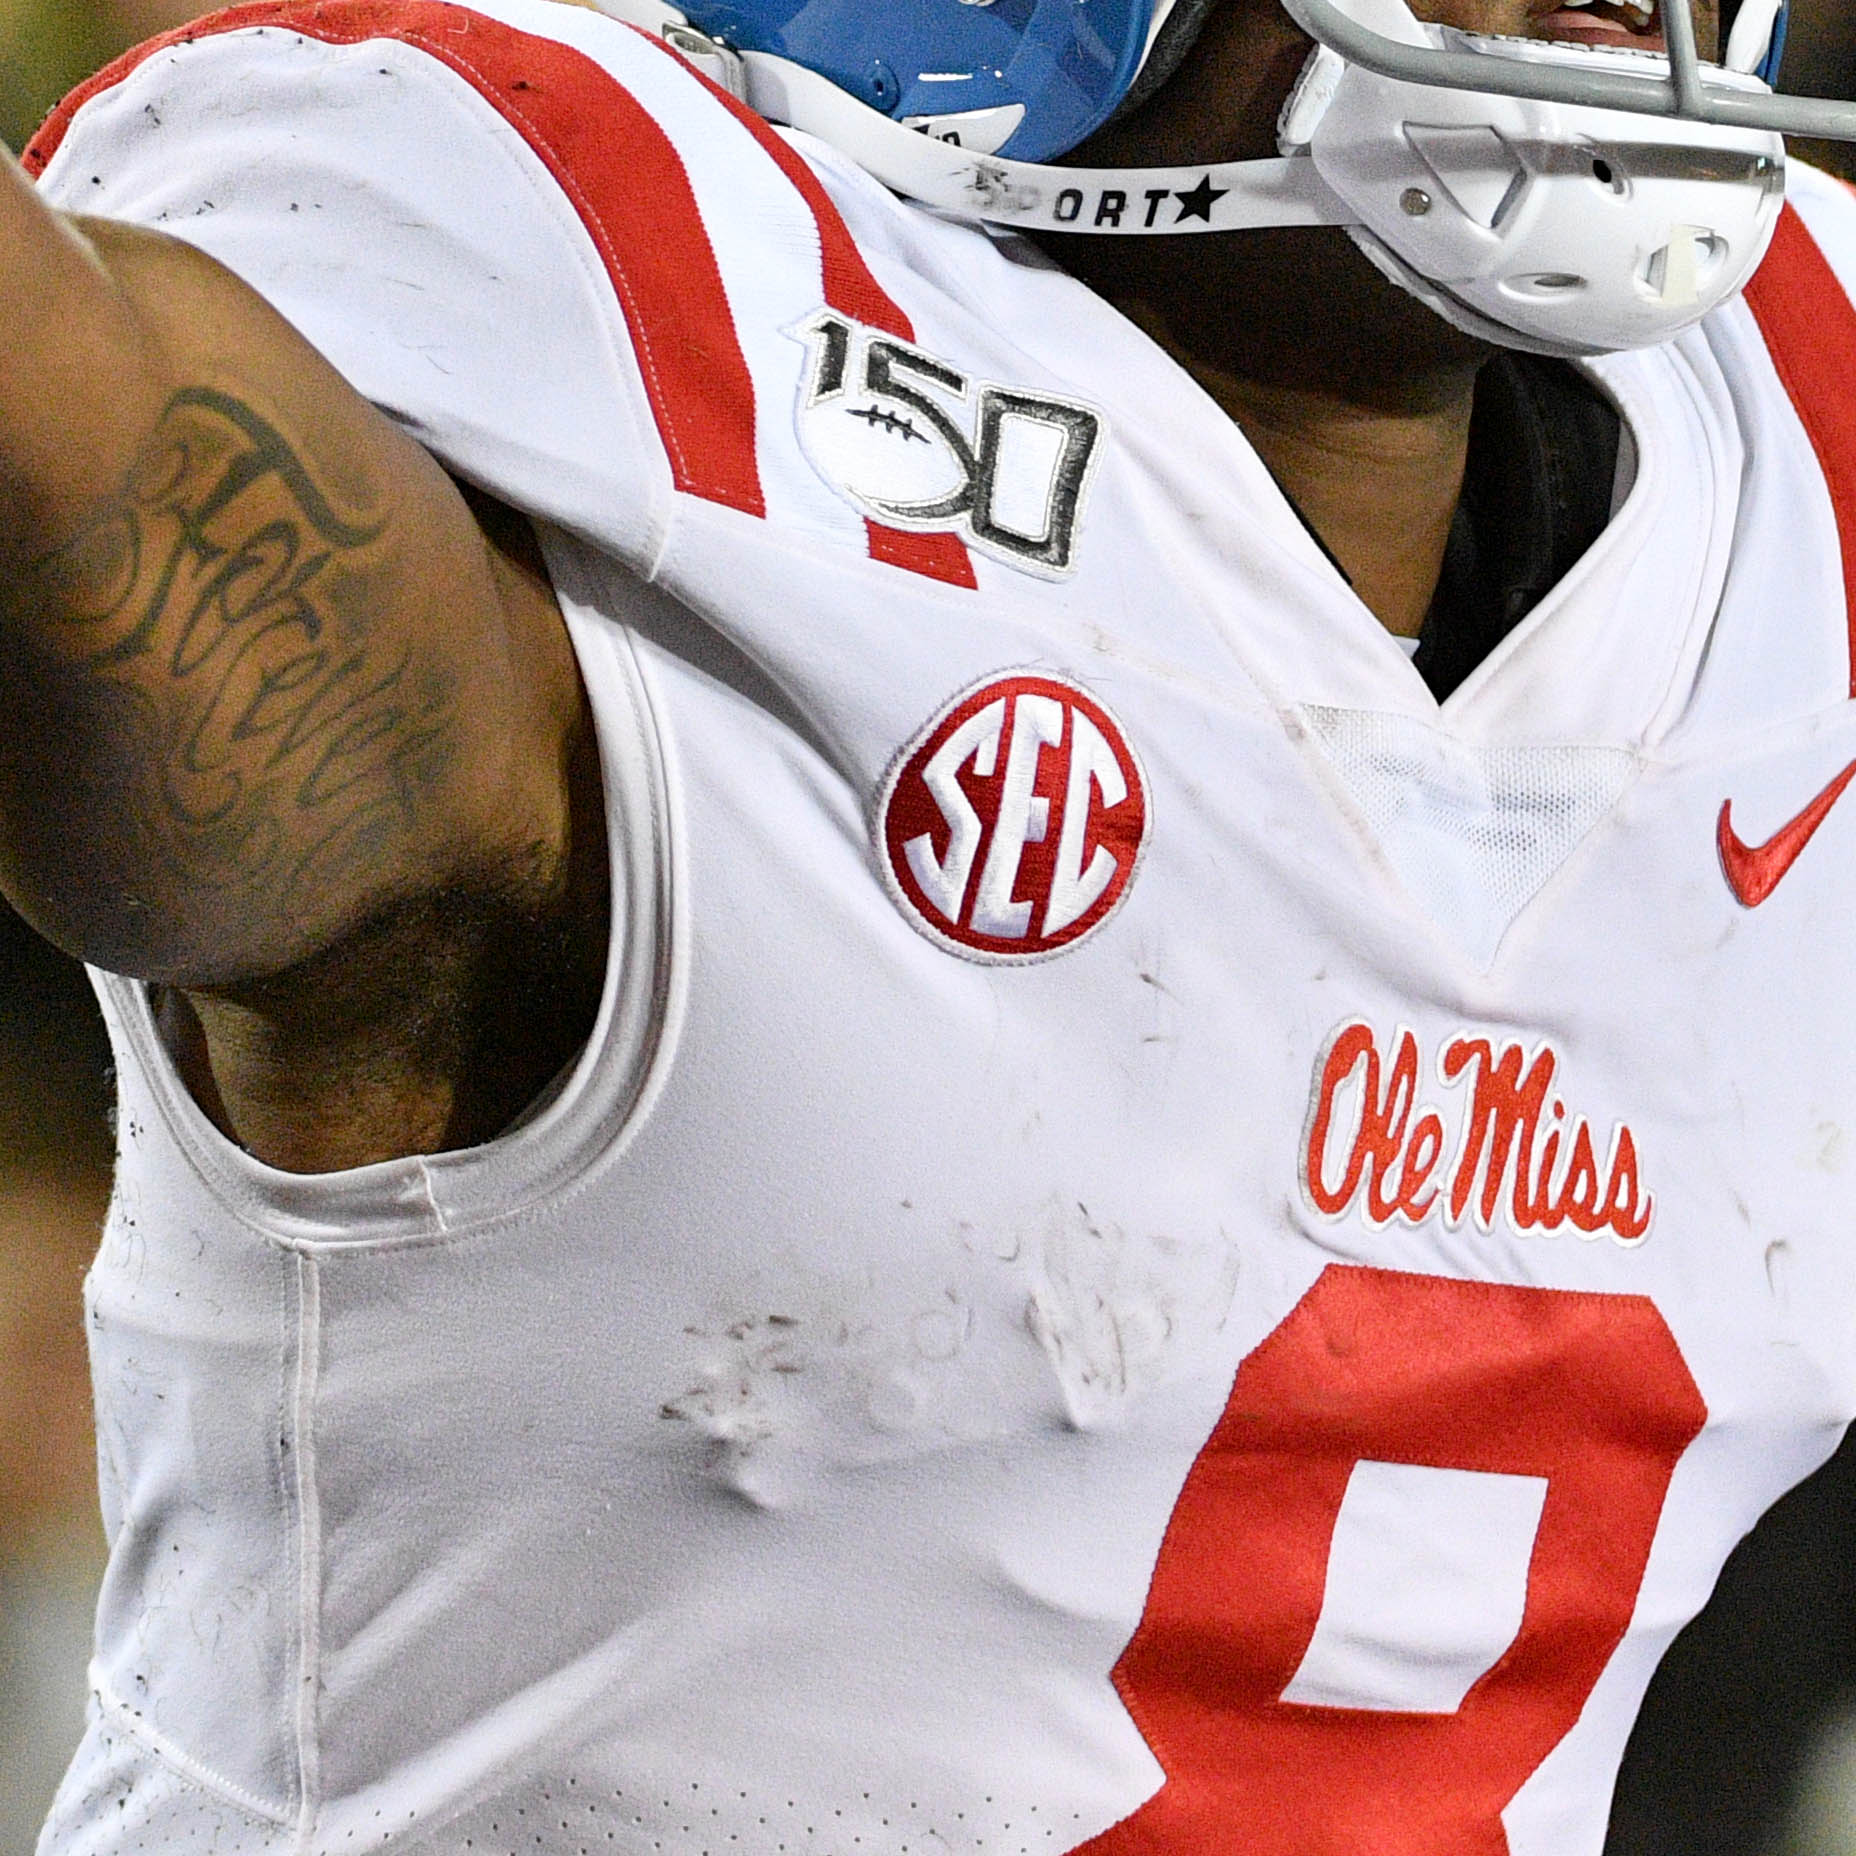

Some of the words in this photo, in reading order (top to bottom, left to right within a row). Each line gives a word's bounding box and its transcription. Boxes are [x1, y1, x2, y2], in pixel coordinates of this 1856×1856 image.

[802, 312, 1104, 578] 150
[901, 692, 1130, 939] SEC
[1300, 1016, 1446, 1232] Ole
[1440, 1034, 1656, 1246] Miss
